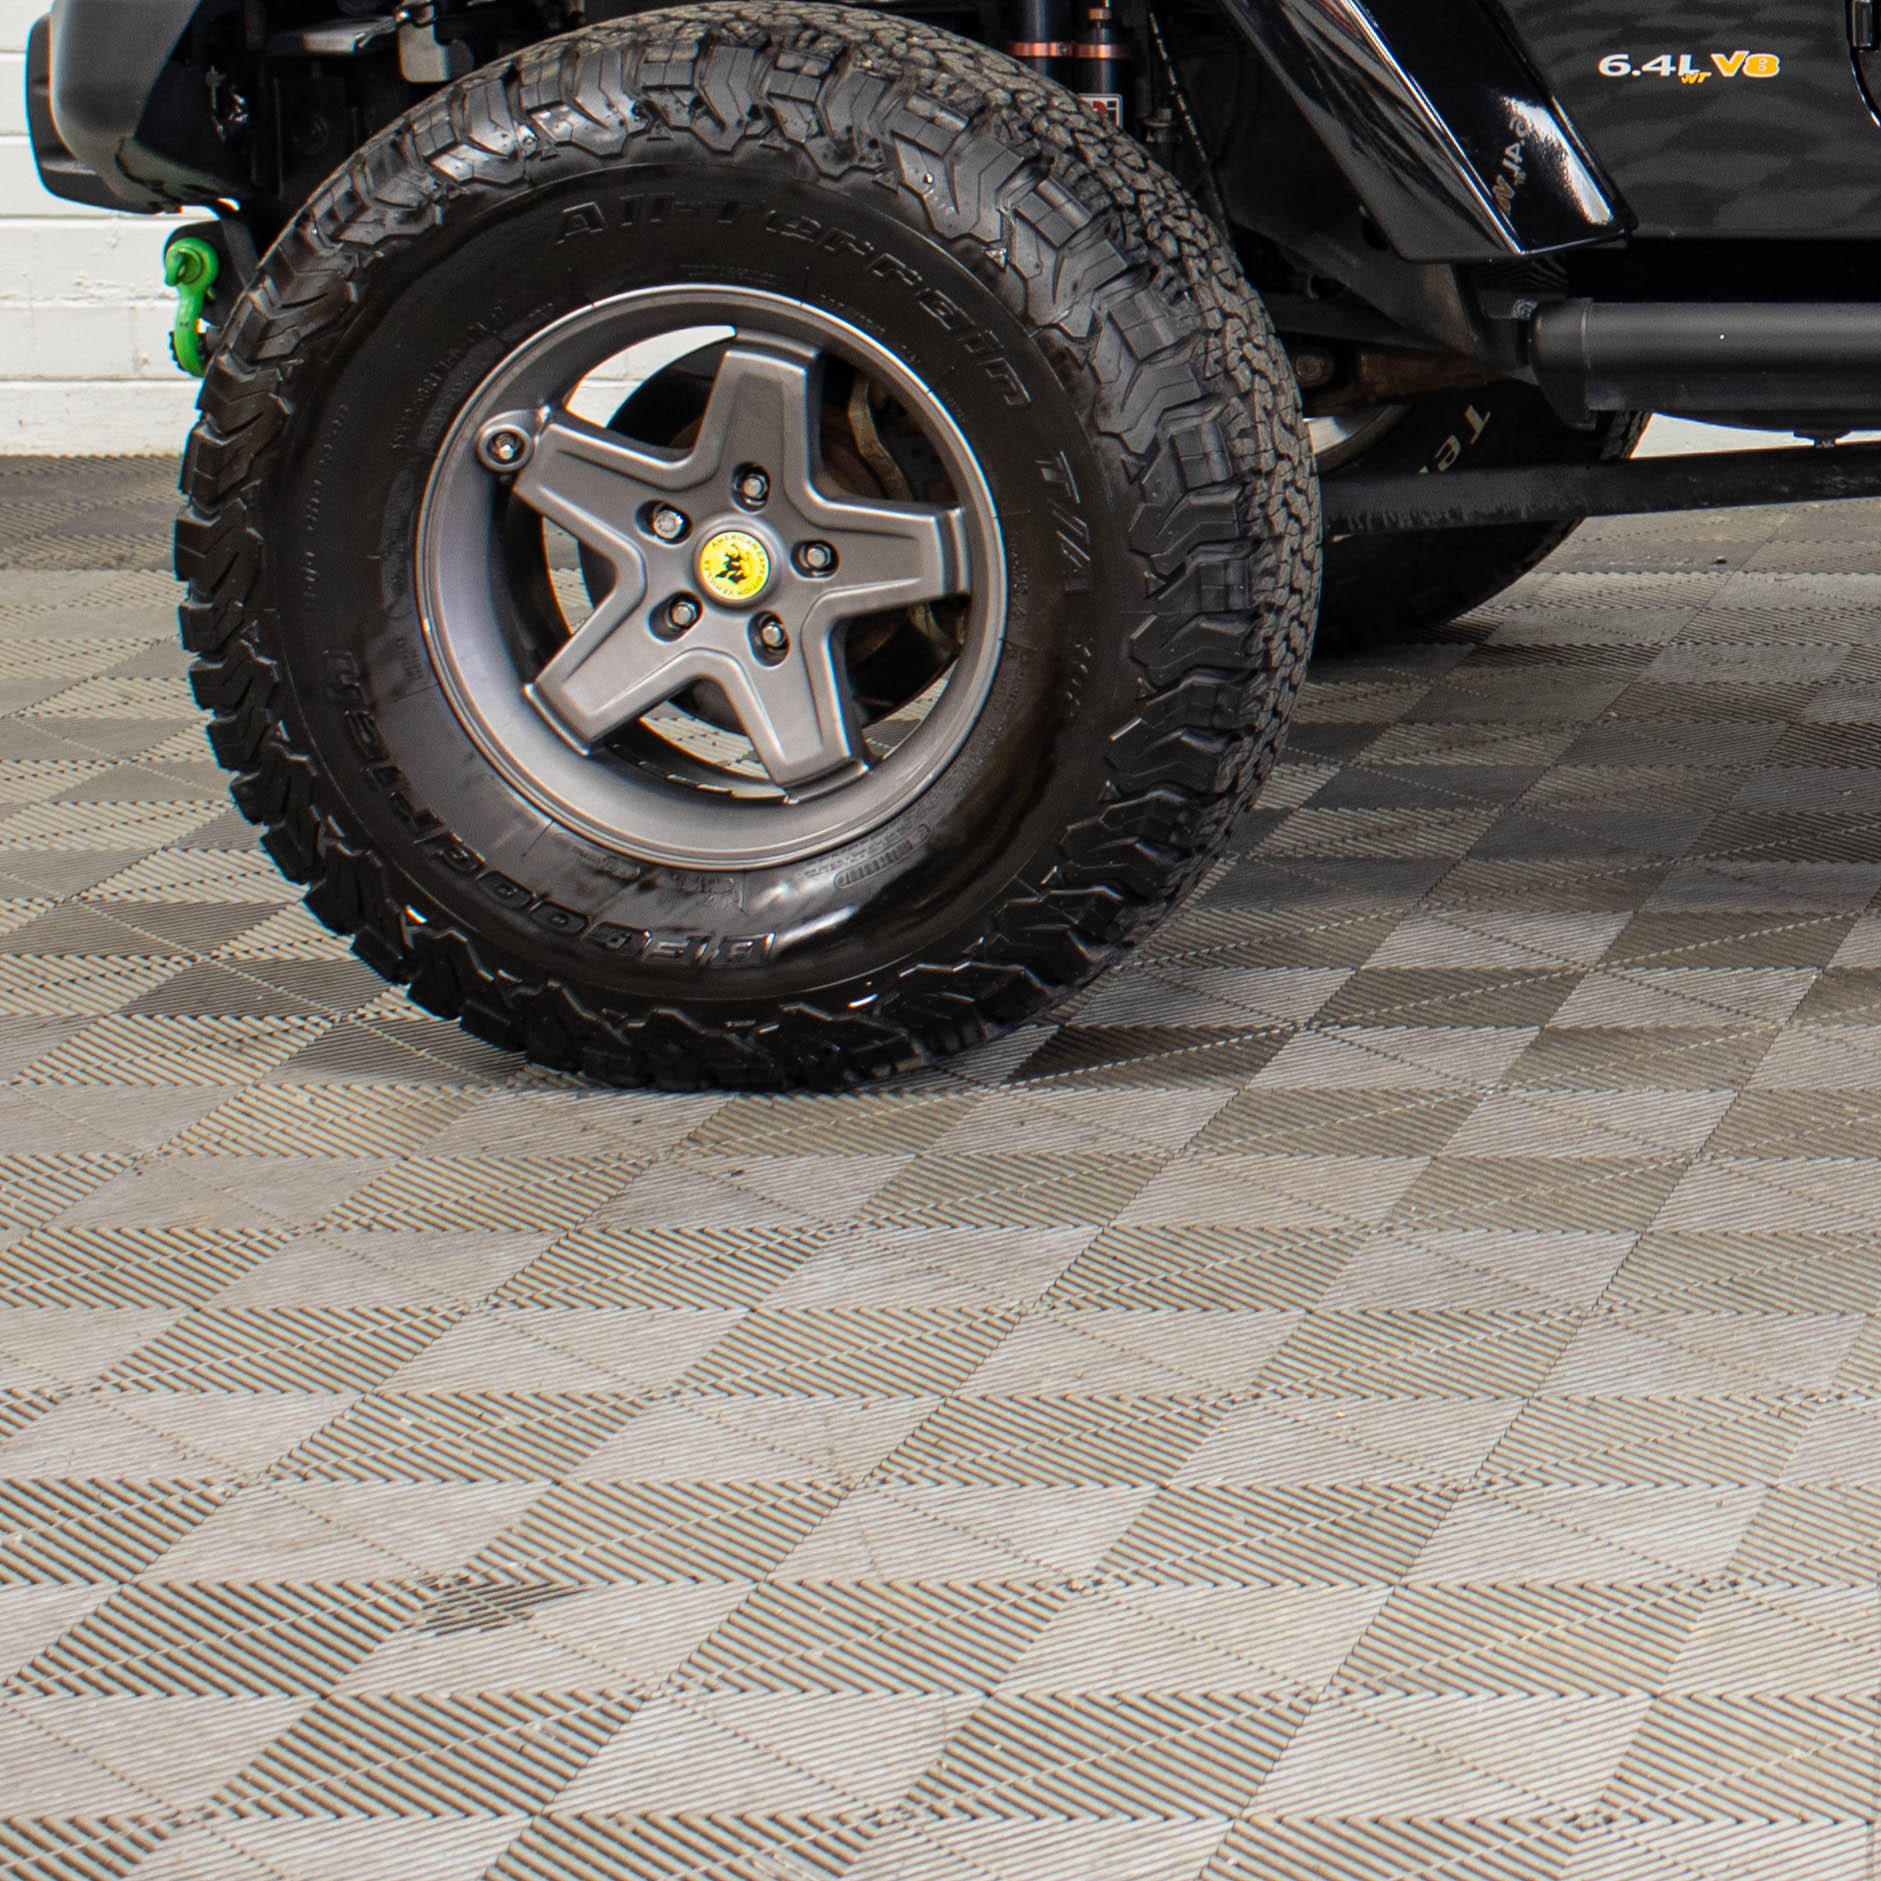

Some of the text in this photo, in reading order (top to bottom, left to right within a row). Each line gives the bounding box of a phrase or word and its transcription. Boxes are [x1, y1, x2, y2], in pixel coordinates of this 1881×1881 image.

[1598, 50, 1780, 77] 6.4L V8
[552, 191, 1034, 408] All-Terrain
